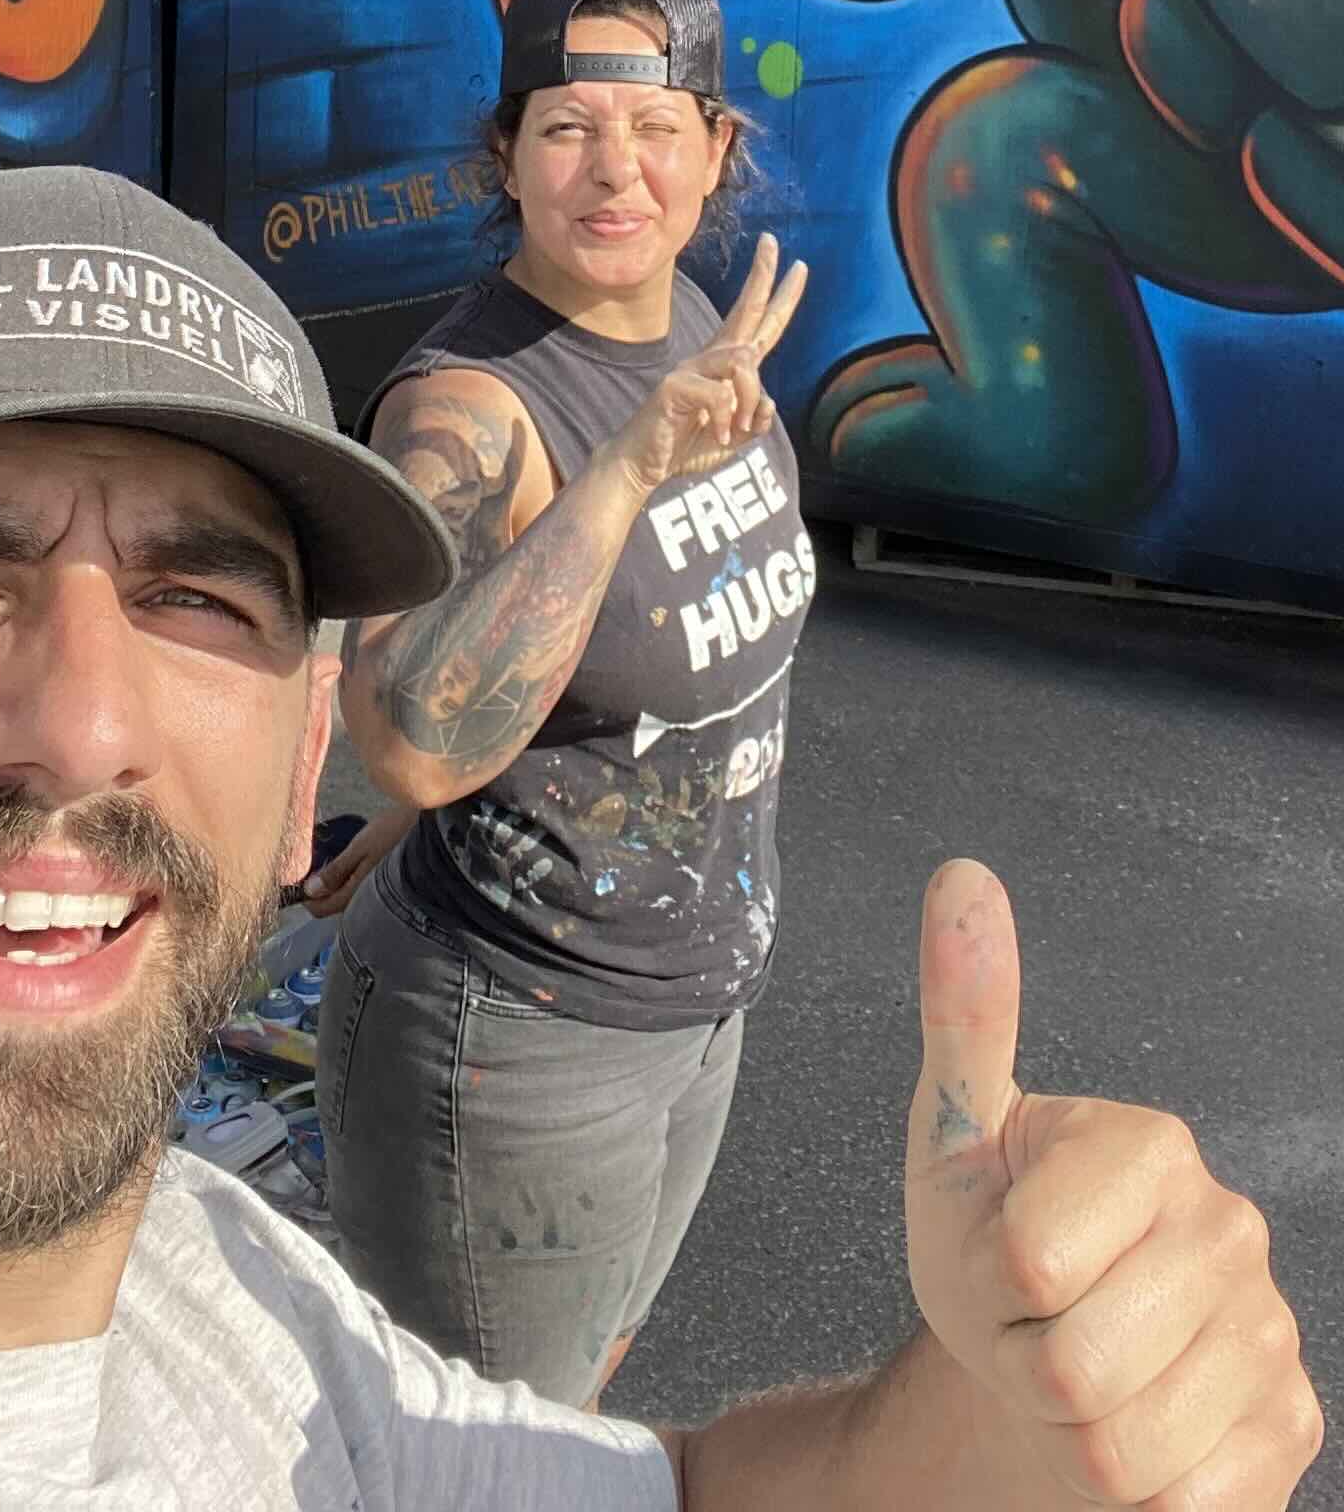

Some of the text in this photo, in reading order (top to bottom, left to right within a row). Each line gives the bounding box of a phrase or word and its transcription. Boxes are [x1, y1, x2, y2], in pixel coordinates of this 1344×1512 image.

[25, 299, 234, 372] VISUEL
[37, 255, 226, 334] LANDRY
[648, 446, 789, 572] FREE
[679, 530, 816, 673] HUGS
